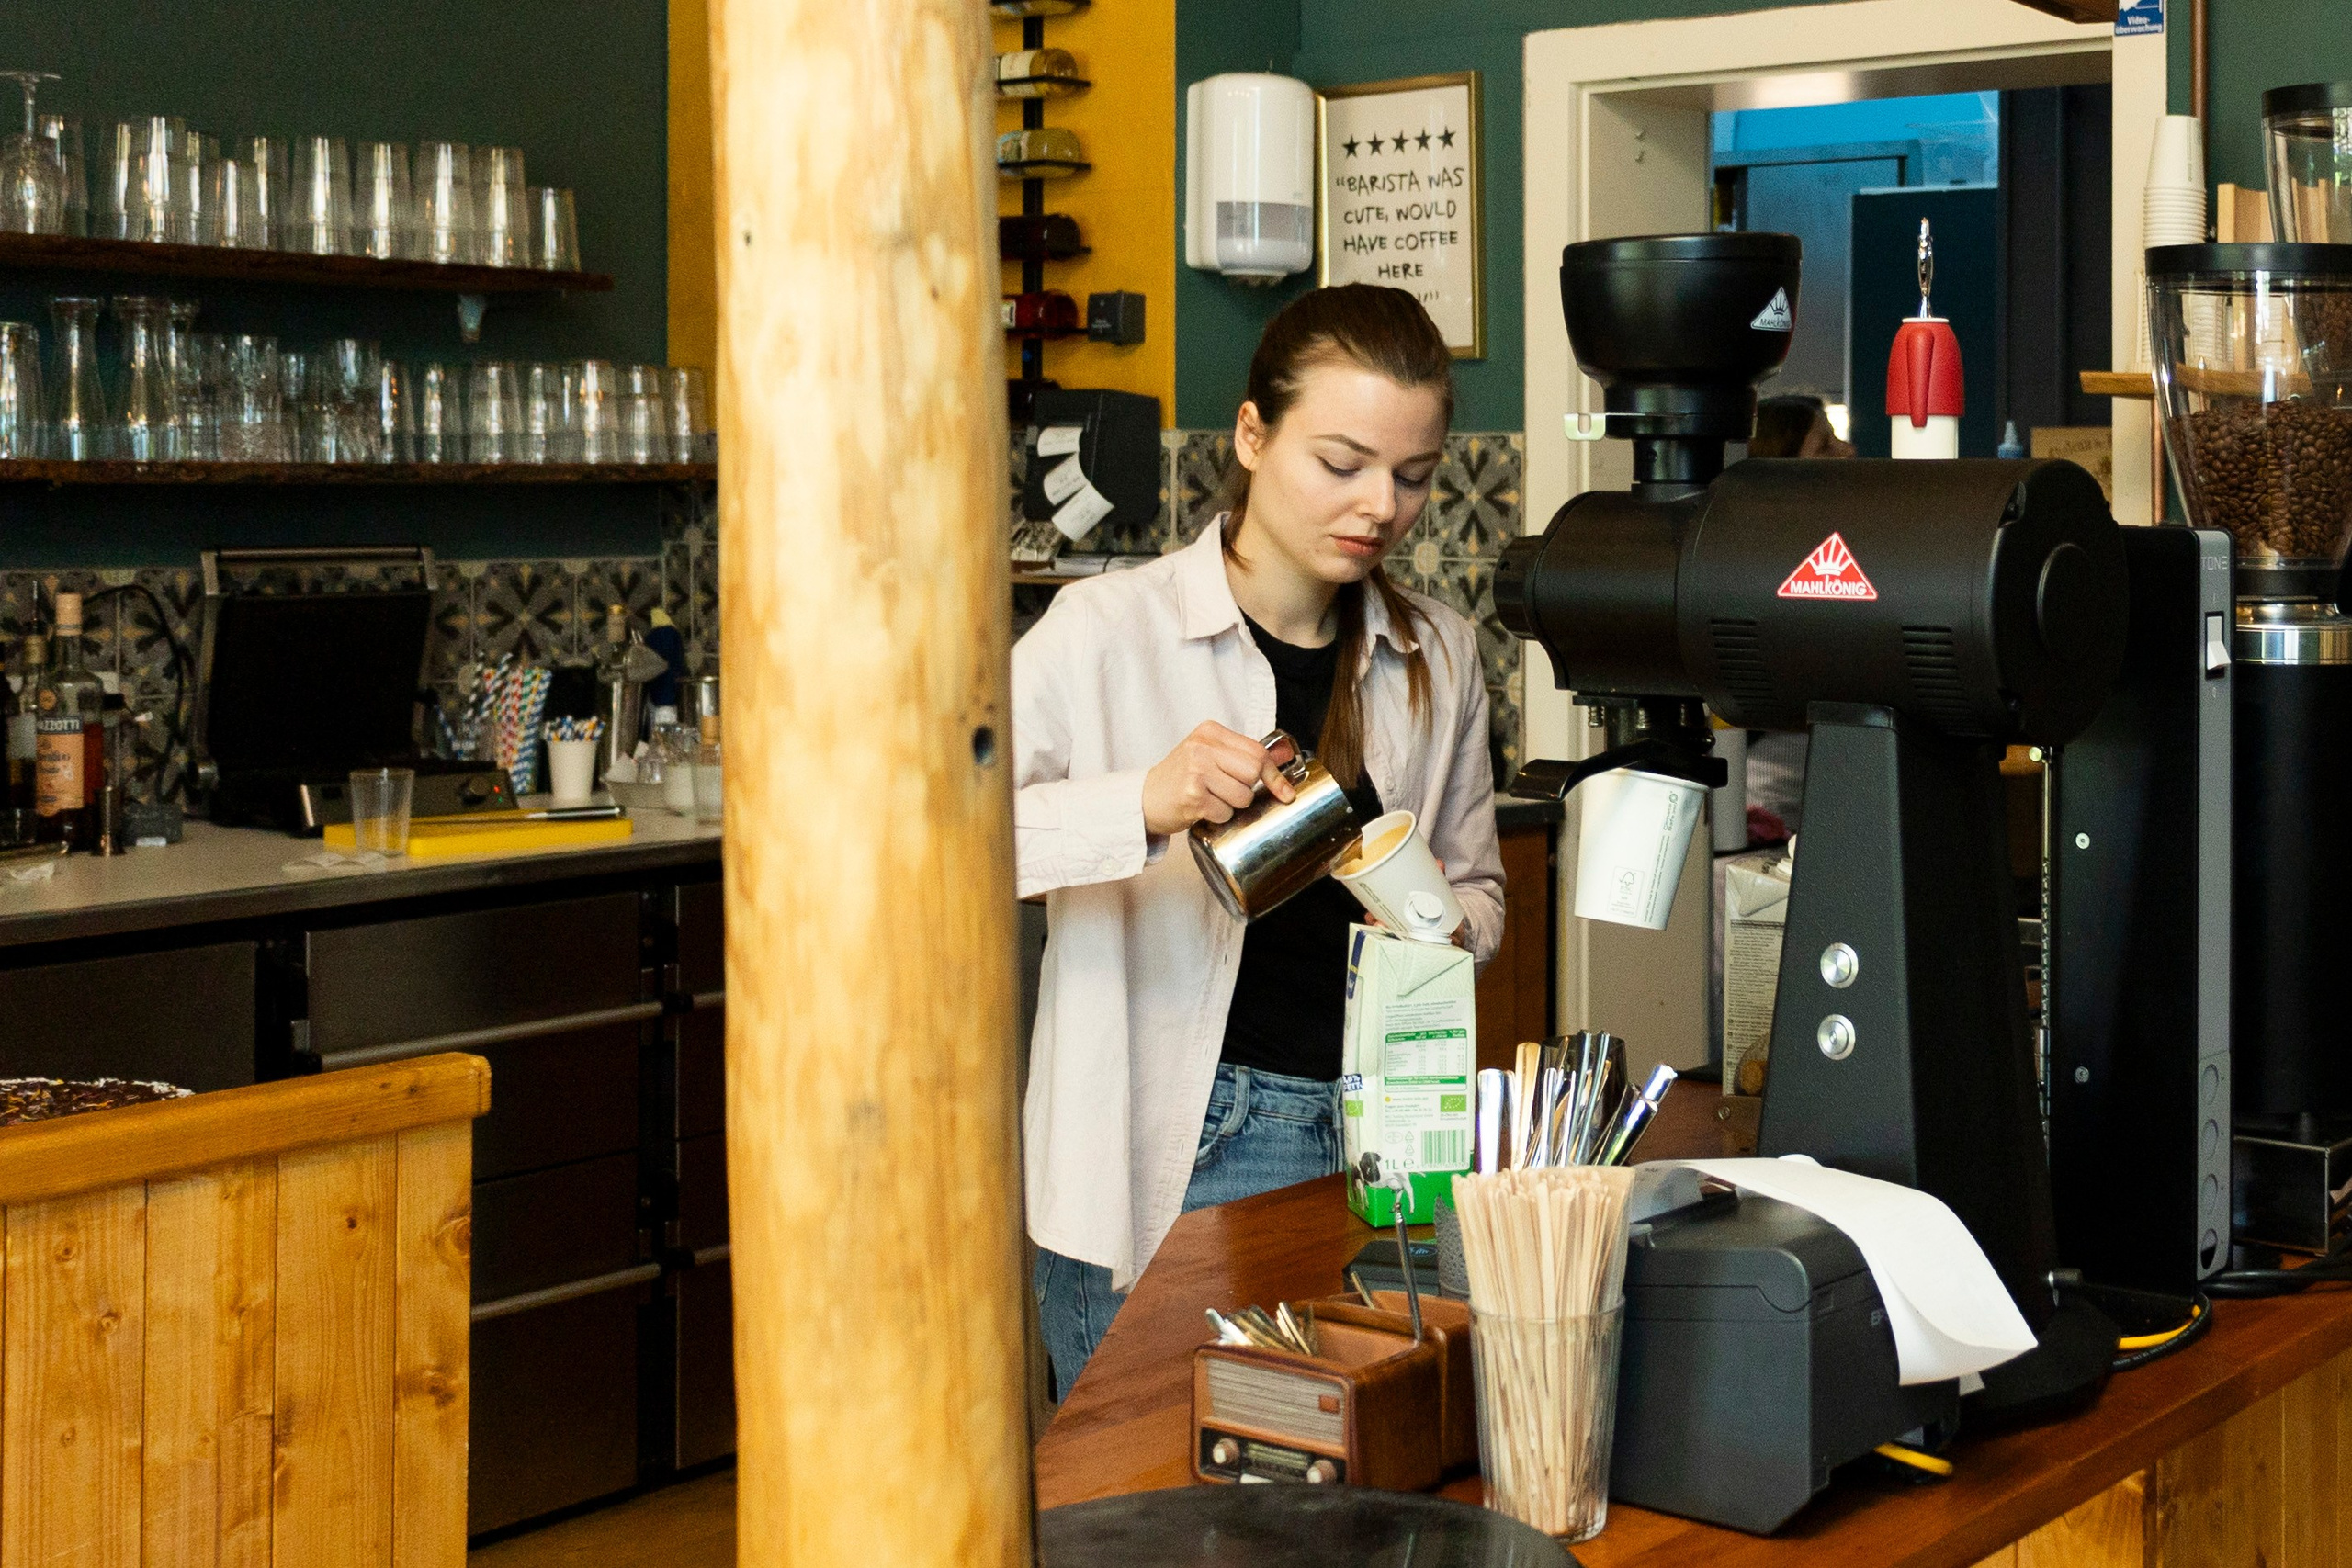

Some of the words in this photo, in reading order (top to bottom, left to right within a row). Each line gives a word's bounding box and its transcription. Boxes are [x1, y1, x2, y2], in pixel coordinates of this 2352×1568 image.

[2127, 15, 2150, 26] Video-
[1428, 167, 1464, 189] WAS
[1344, 207, 1389, 224] CUTE,
[1396, 200, 1457, 222] WOULD
[1344, 234, 1388, 255] HAVE
[1395, 231, 1458, 251] COFFEE
[1378, 263, 1424, 279] HERE
[1790, 576, 1867, 596] MAHLKÖNIG
